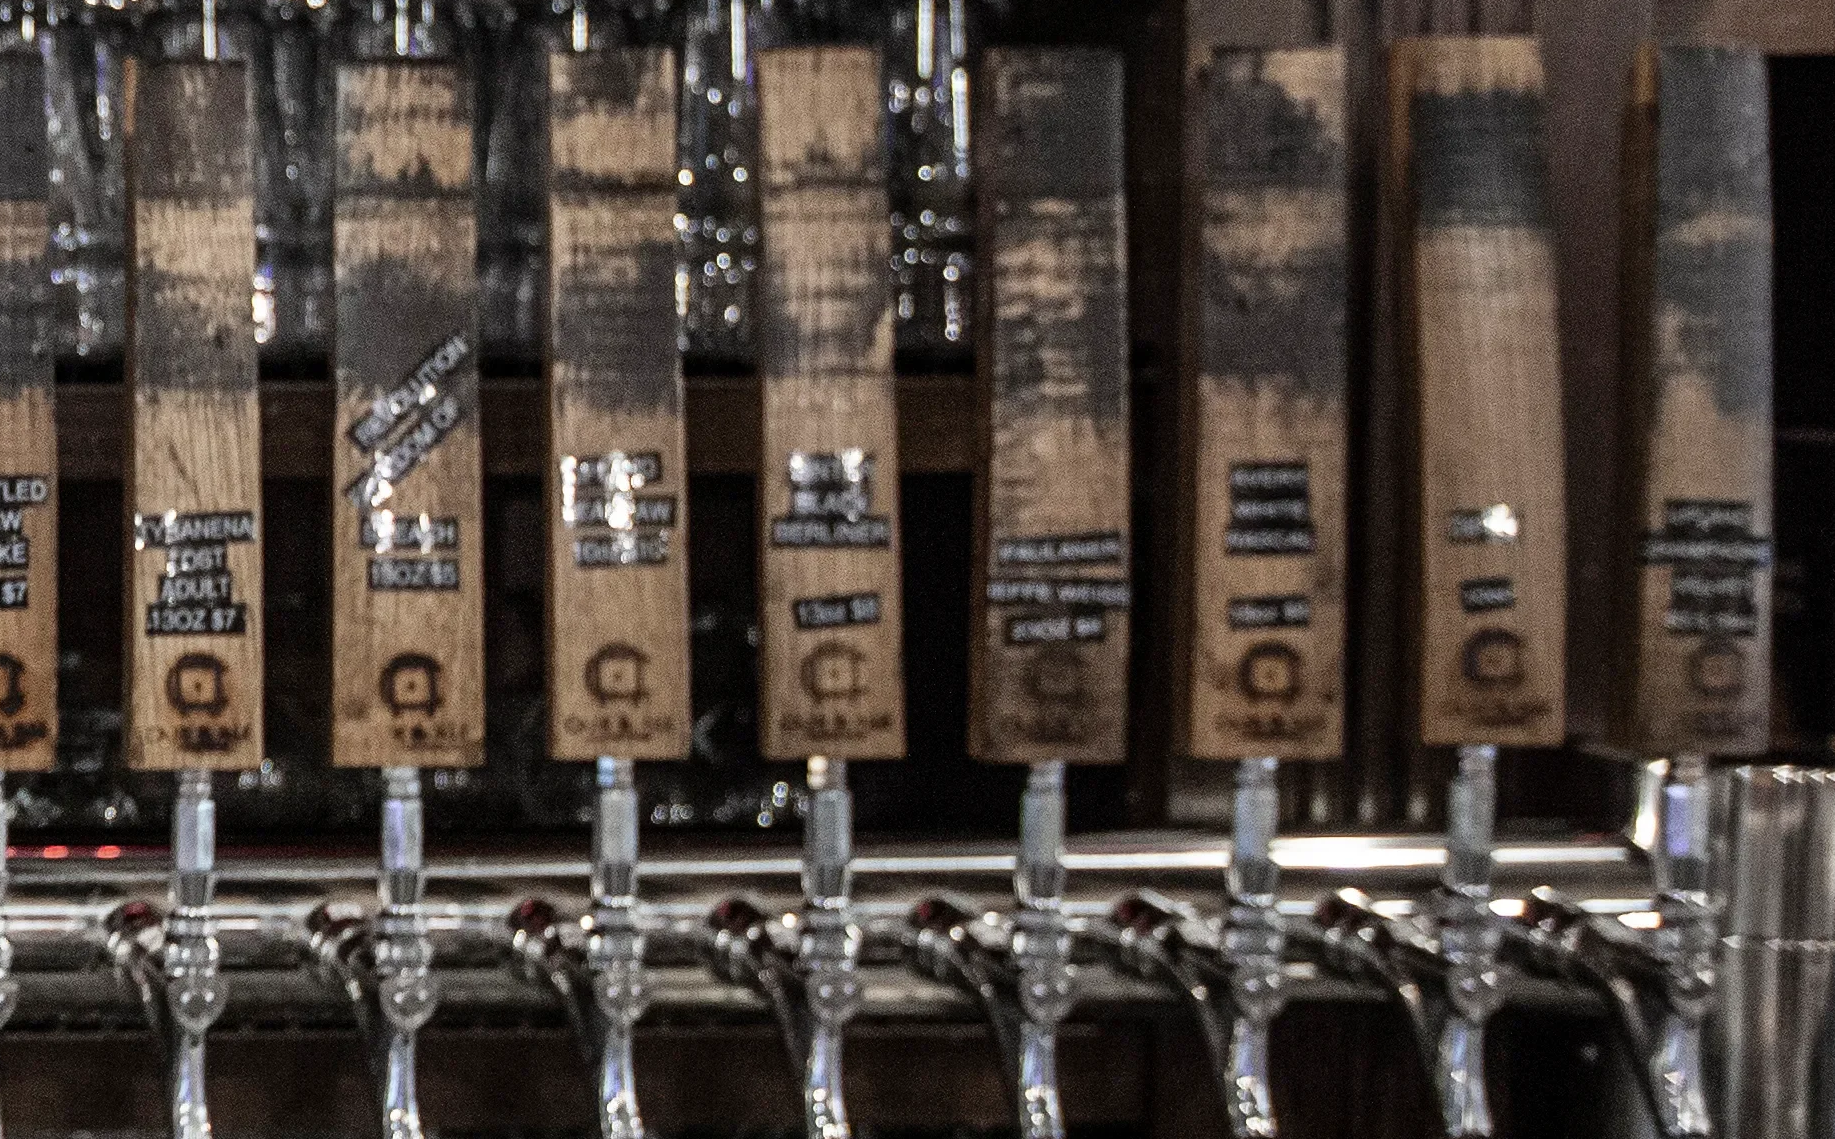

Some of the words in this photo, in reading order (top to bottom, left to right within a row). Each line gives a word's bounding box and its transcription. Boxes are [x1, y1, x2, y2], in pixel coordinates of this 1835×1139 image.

[774, 518, 890, 543] BERLINER
[1, 583, 27, 608] $7
[161, 576, 232, 603] ADULT
